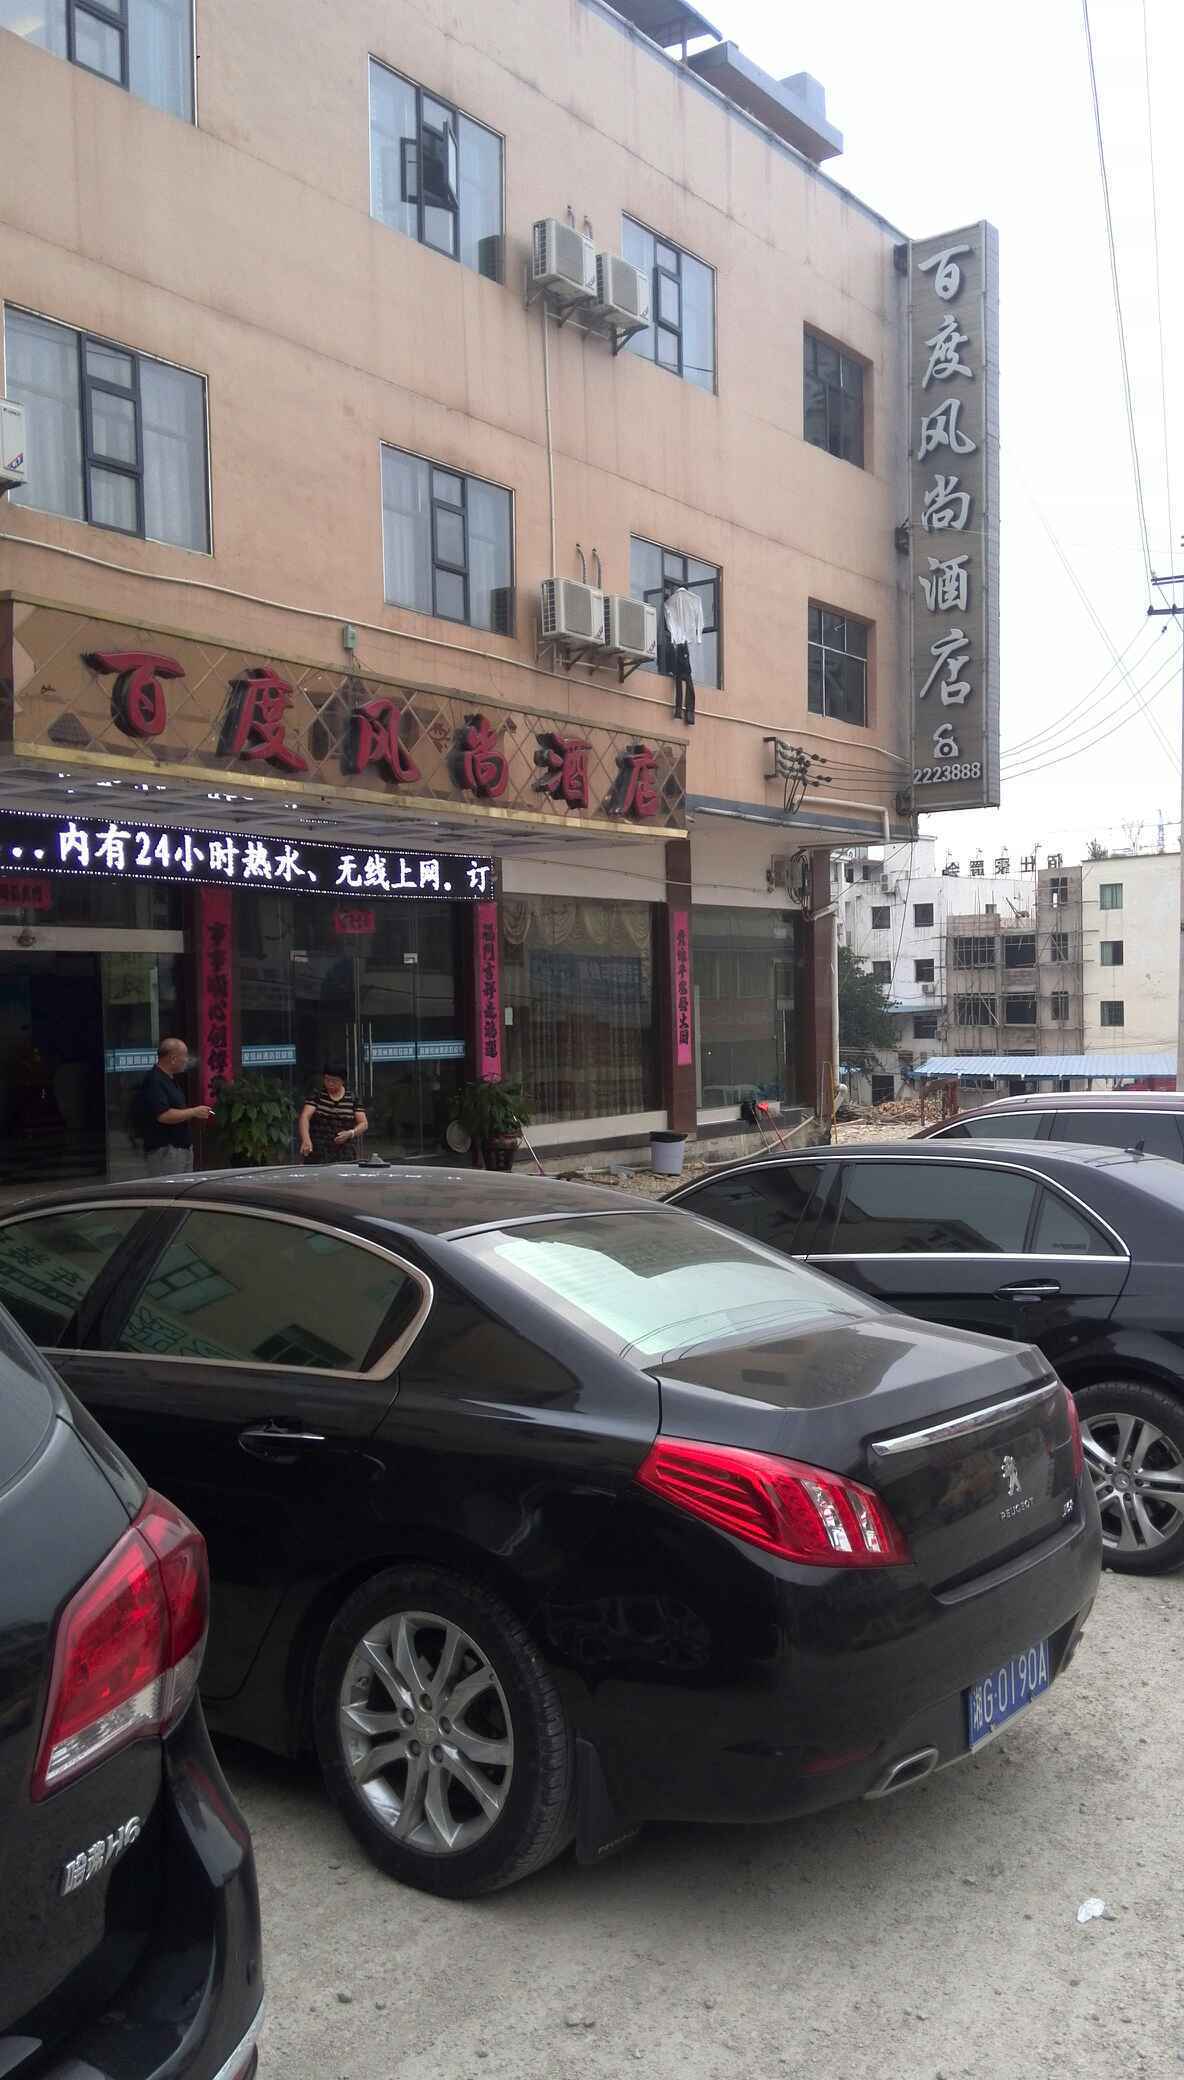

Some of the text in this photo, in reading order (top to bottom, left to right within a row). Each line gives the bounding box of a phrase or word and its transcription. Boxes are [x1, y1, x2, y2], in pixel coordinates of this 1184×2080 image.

[918, 243, 975, 706] 百度风尚酒店
[82, 650, 659, 818] 百度风尚酒店
[913, 762, 981, 784] 2223888
